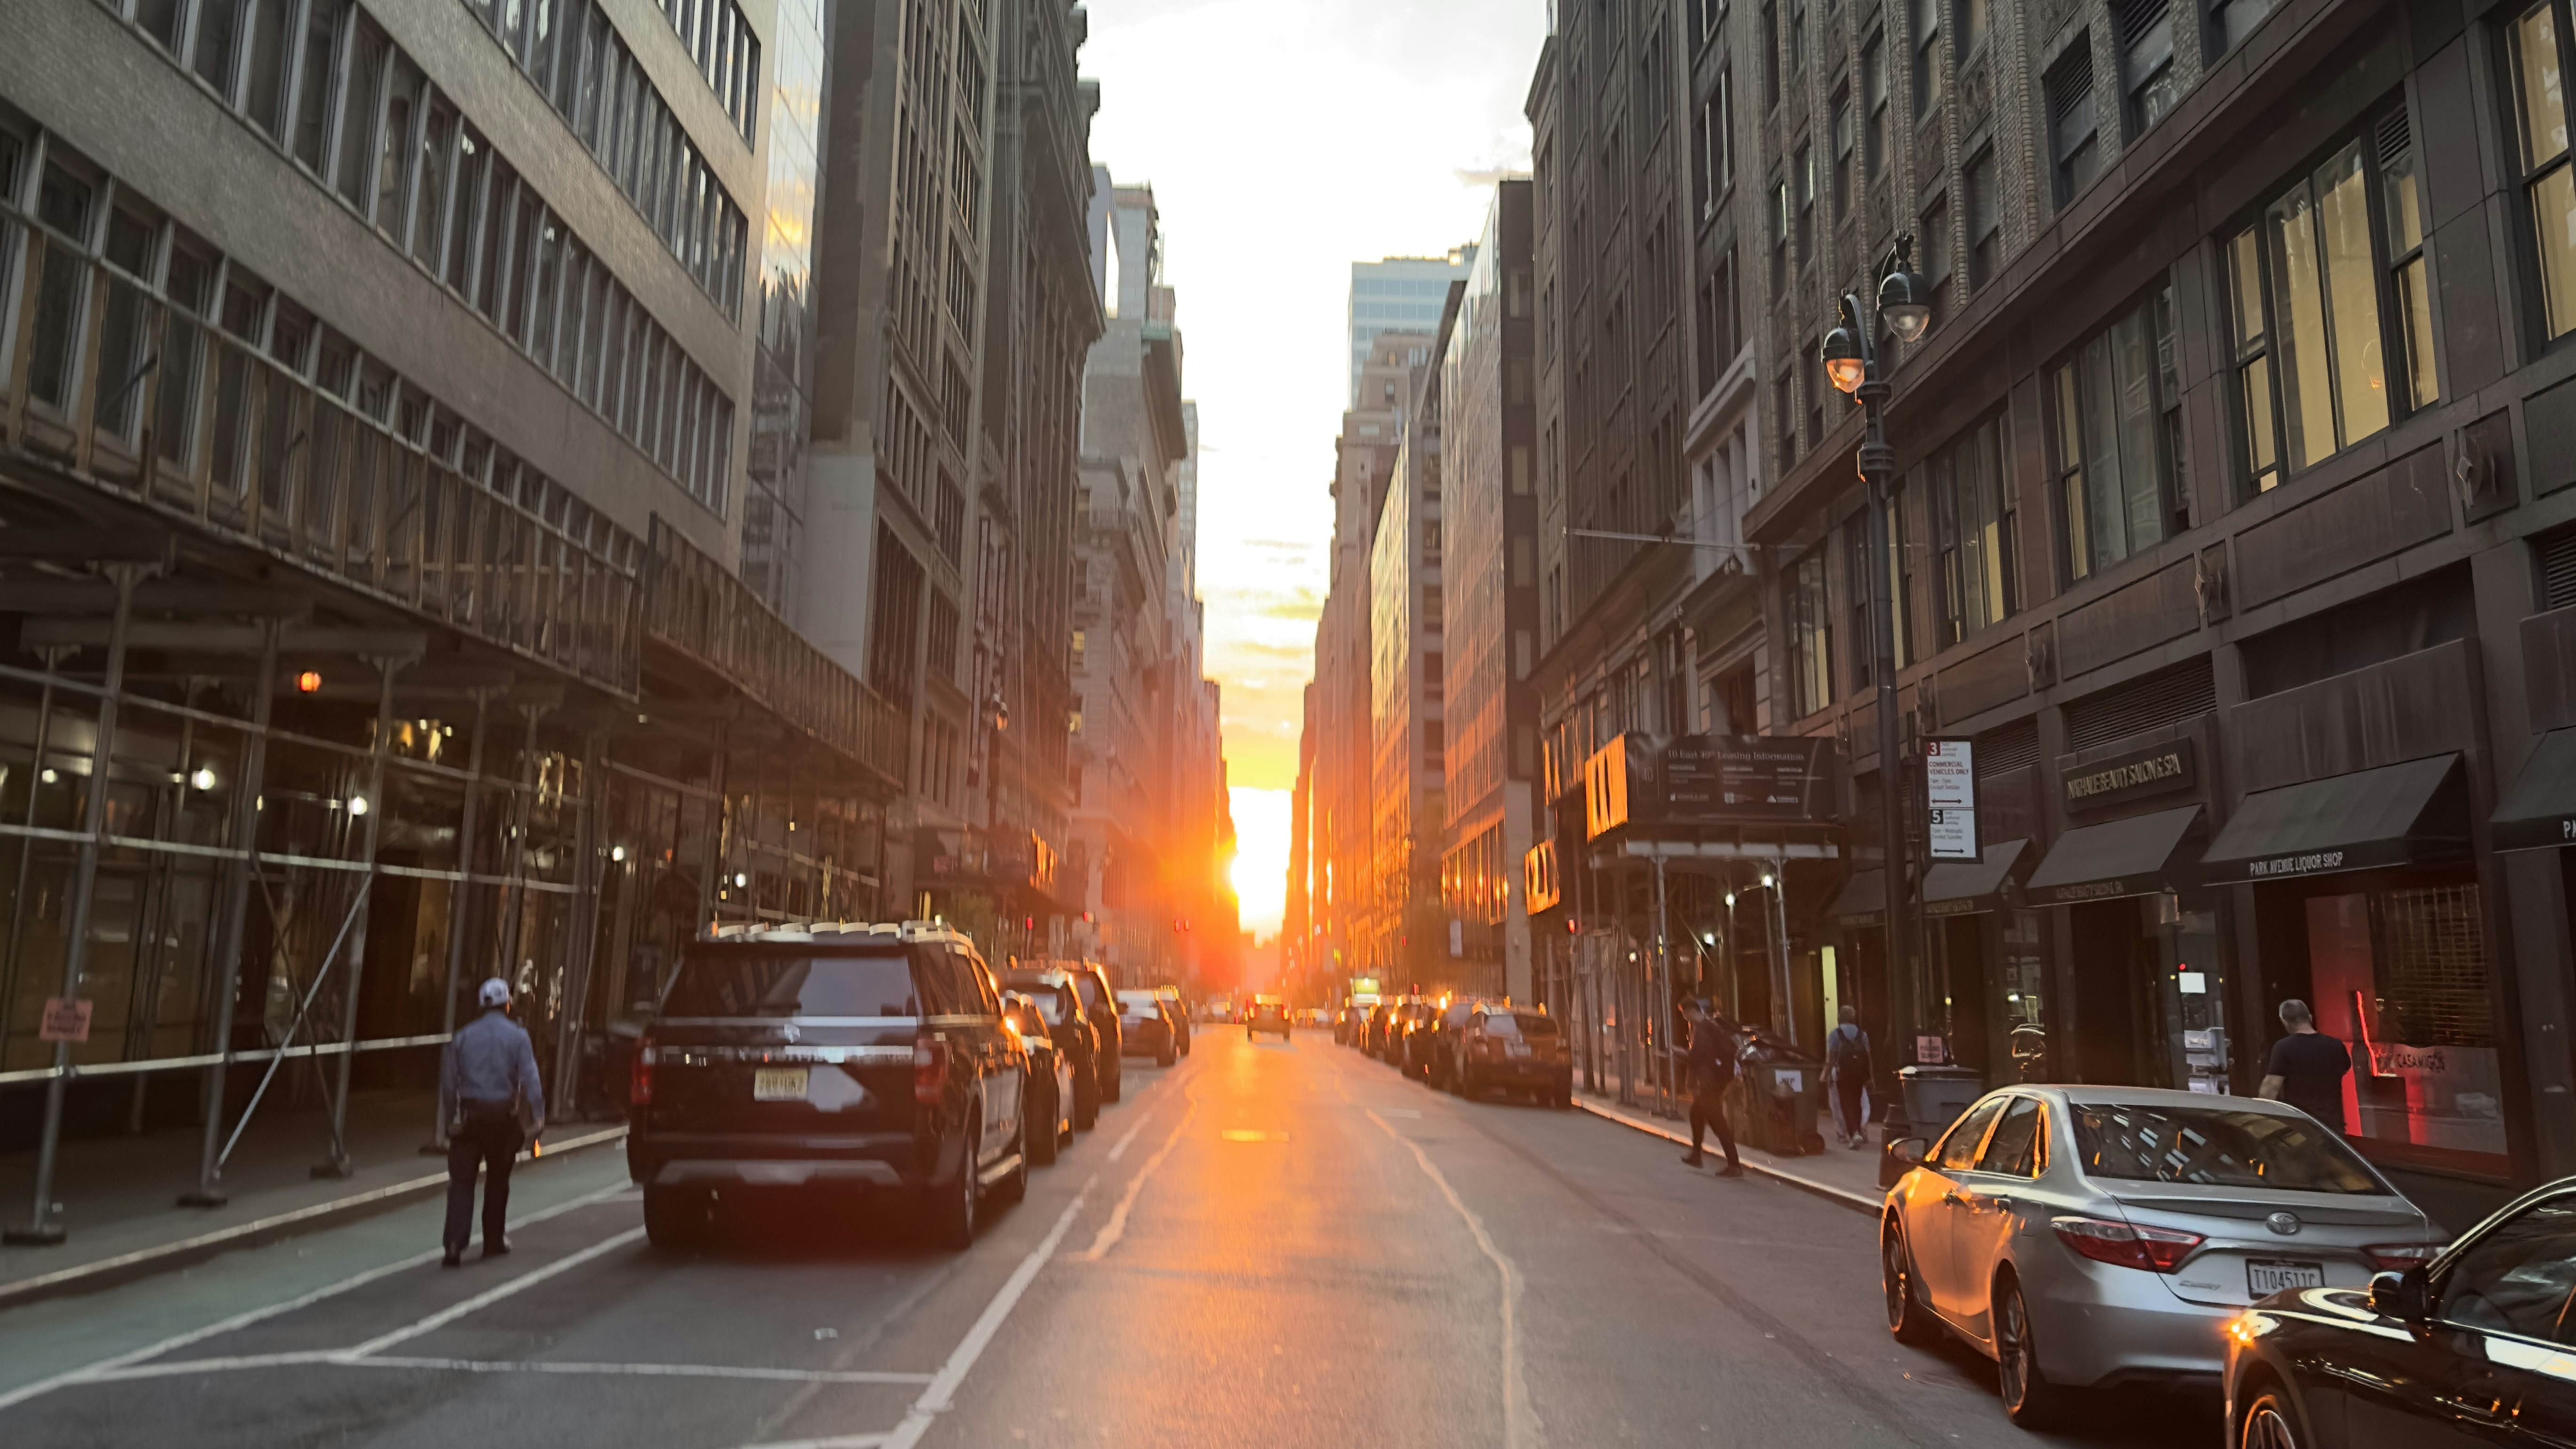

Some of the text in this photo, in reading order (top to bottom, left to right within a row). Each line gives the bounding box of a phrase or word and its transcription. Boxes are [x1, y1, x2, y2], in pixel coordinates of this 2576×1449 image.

[1930, 742, 1938, 755] 3
[1753, 752, 1804, 761] Information
[2129, 760, 2157, 785] SALON
[2164, 754, 2181, 776] SPA
[1932, 810, 1940, 823] 5
[2250, 851, 2343, 876] PARK AVENUE LIQUOR SHOP
